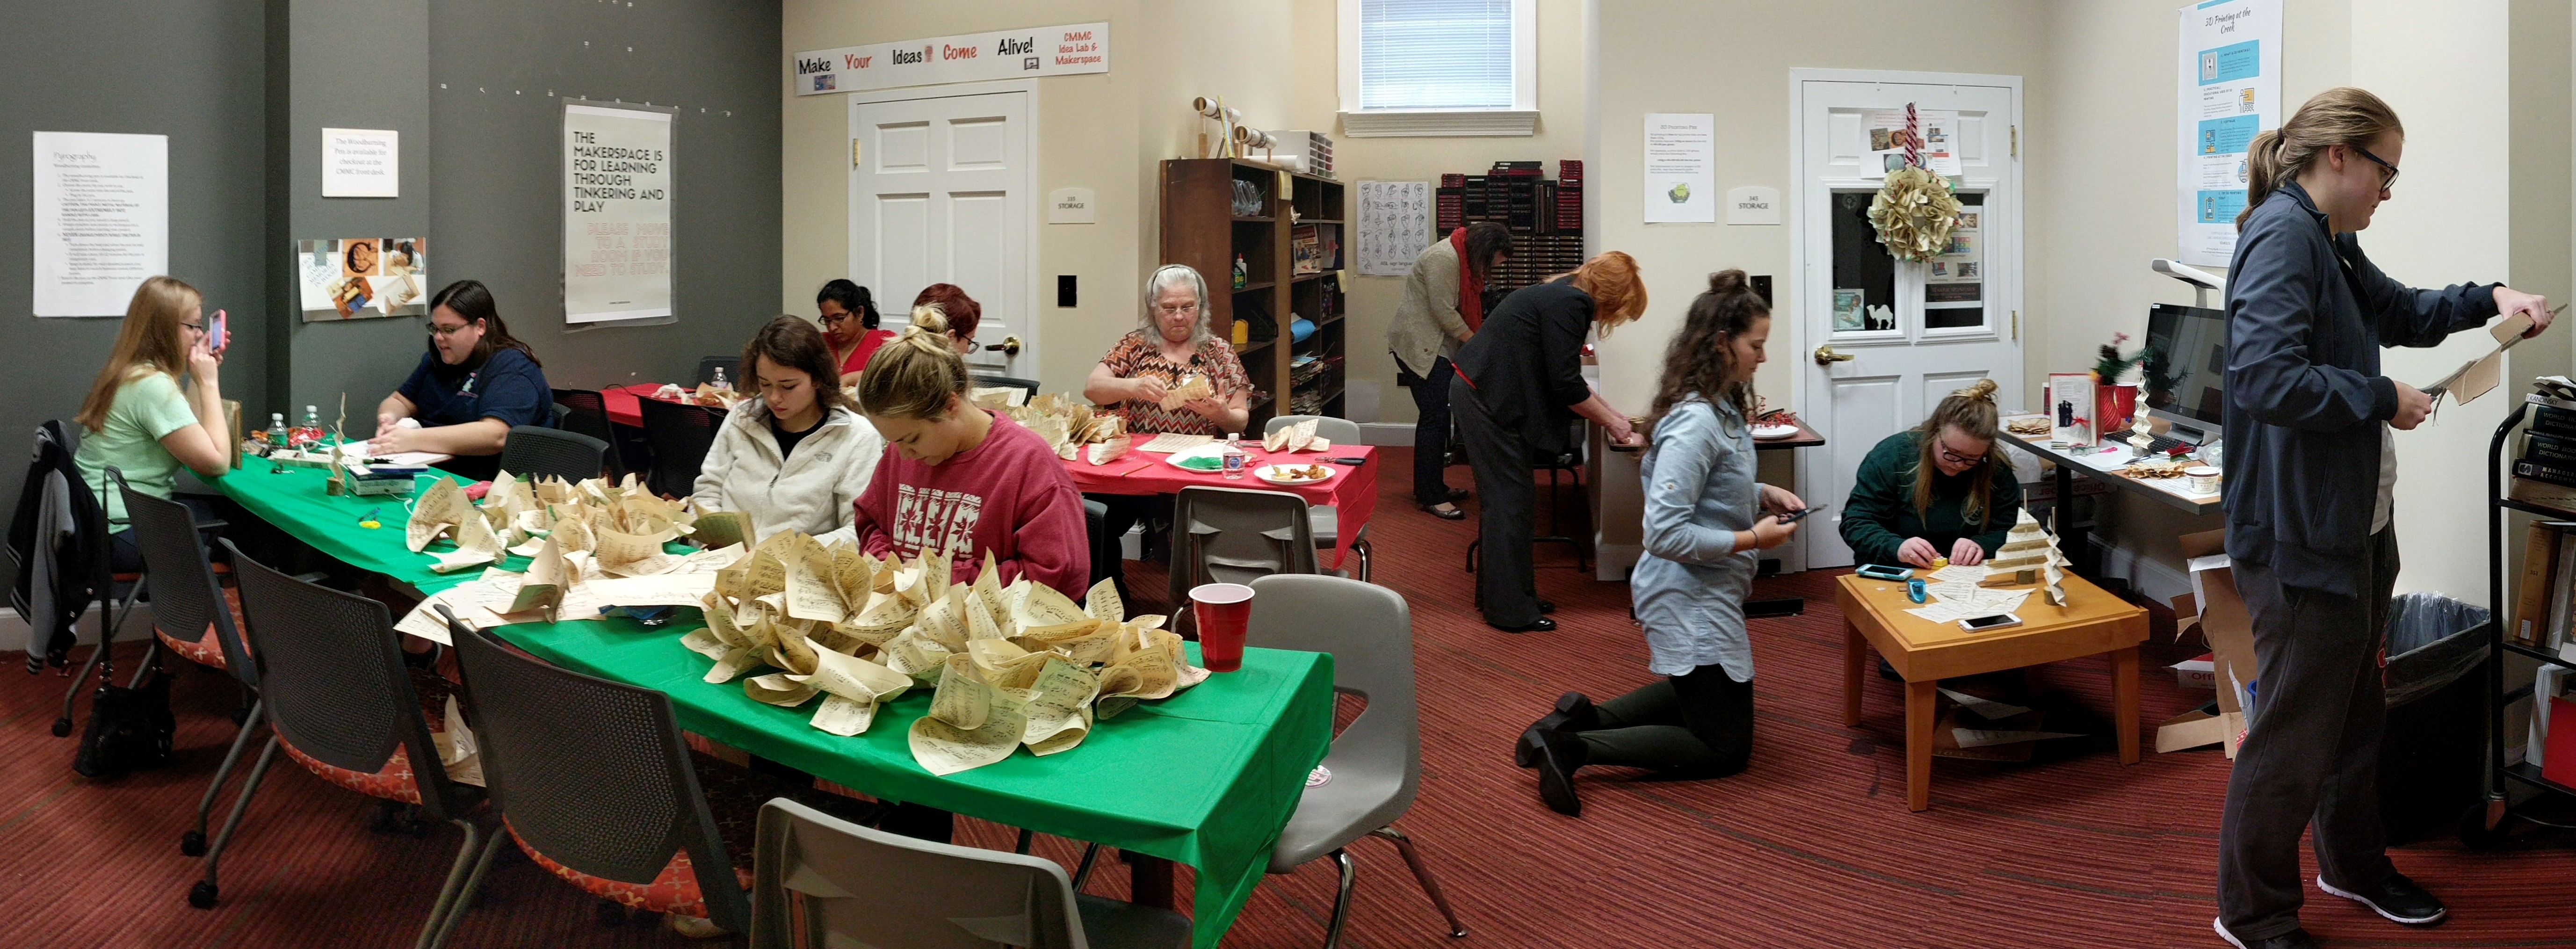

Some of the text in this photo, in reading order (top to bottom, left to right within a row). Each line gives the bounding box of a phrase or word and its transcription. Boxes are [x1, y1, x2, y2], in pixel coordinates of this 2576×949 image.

[2206, 17, 2213, 26] 3D
[2215, 13, 2235, 24] Printing
[2221, 22, 2235, 34] Creek
[1064, 31, 1092, 42] CMMC
[1059, 43, 1098, 53] Idea Lab &
[798, 37, 1033, 74] Make Your Ideas Come Alive!
[1056, 55, 1101, 65] Makerspace
[347, 138, 386, 147] Woodburning
[573, 131, 595, 144] THE
[574, 146, 662, 161] MAKERSPACE IS
[574, 159, 657, 174] FOR LEARNING
[573, 173, 631, 186] THROUGH
[574, 187, 664, 200] TINKERING AND
[574, 201, 605, 212] PLAY
[587, 223, 668, 235] PLEASE MOVE
[596, 236, 668, 248] TO A STUDY
[591, 249, 668, 262] ROOM IF YOU
[575, 264, 606, 276] NEED
[610, 263, 626, 275] TO
[2529, 396, 2558, 405] KANDINSKY
